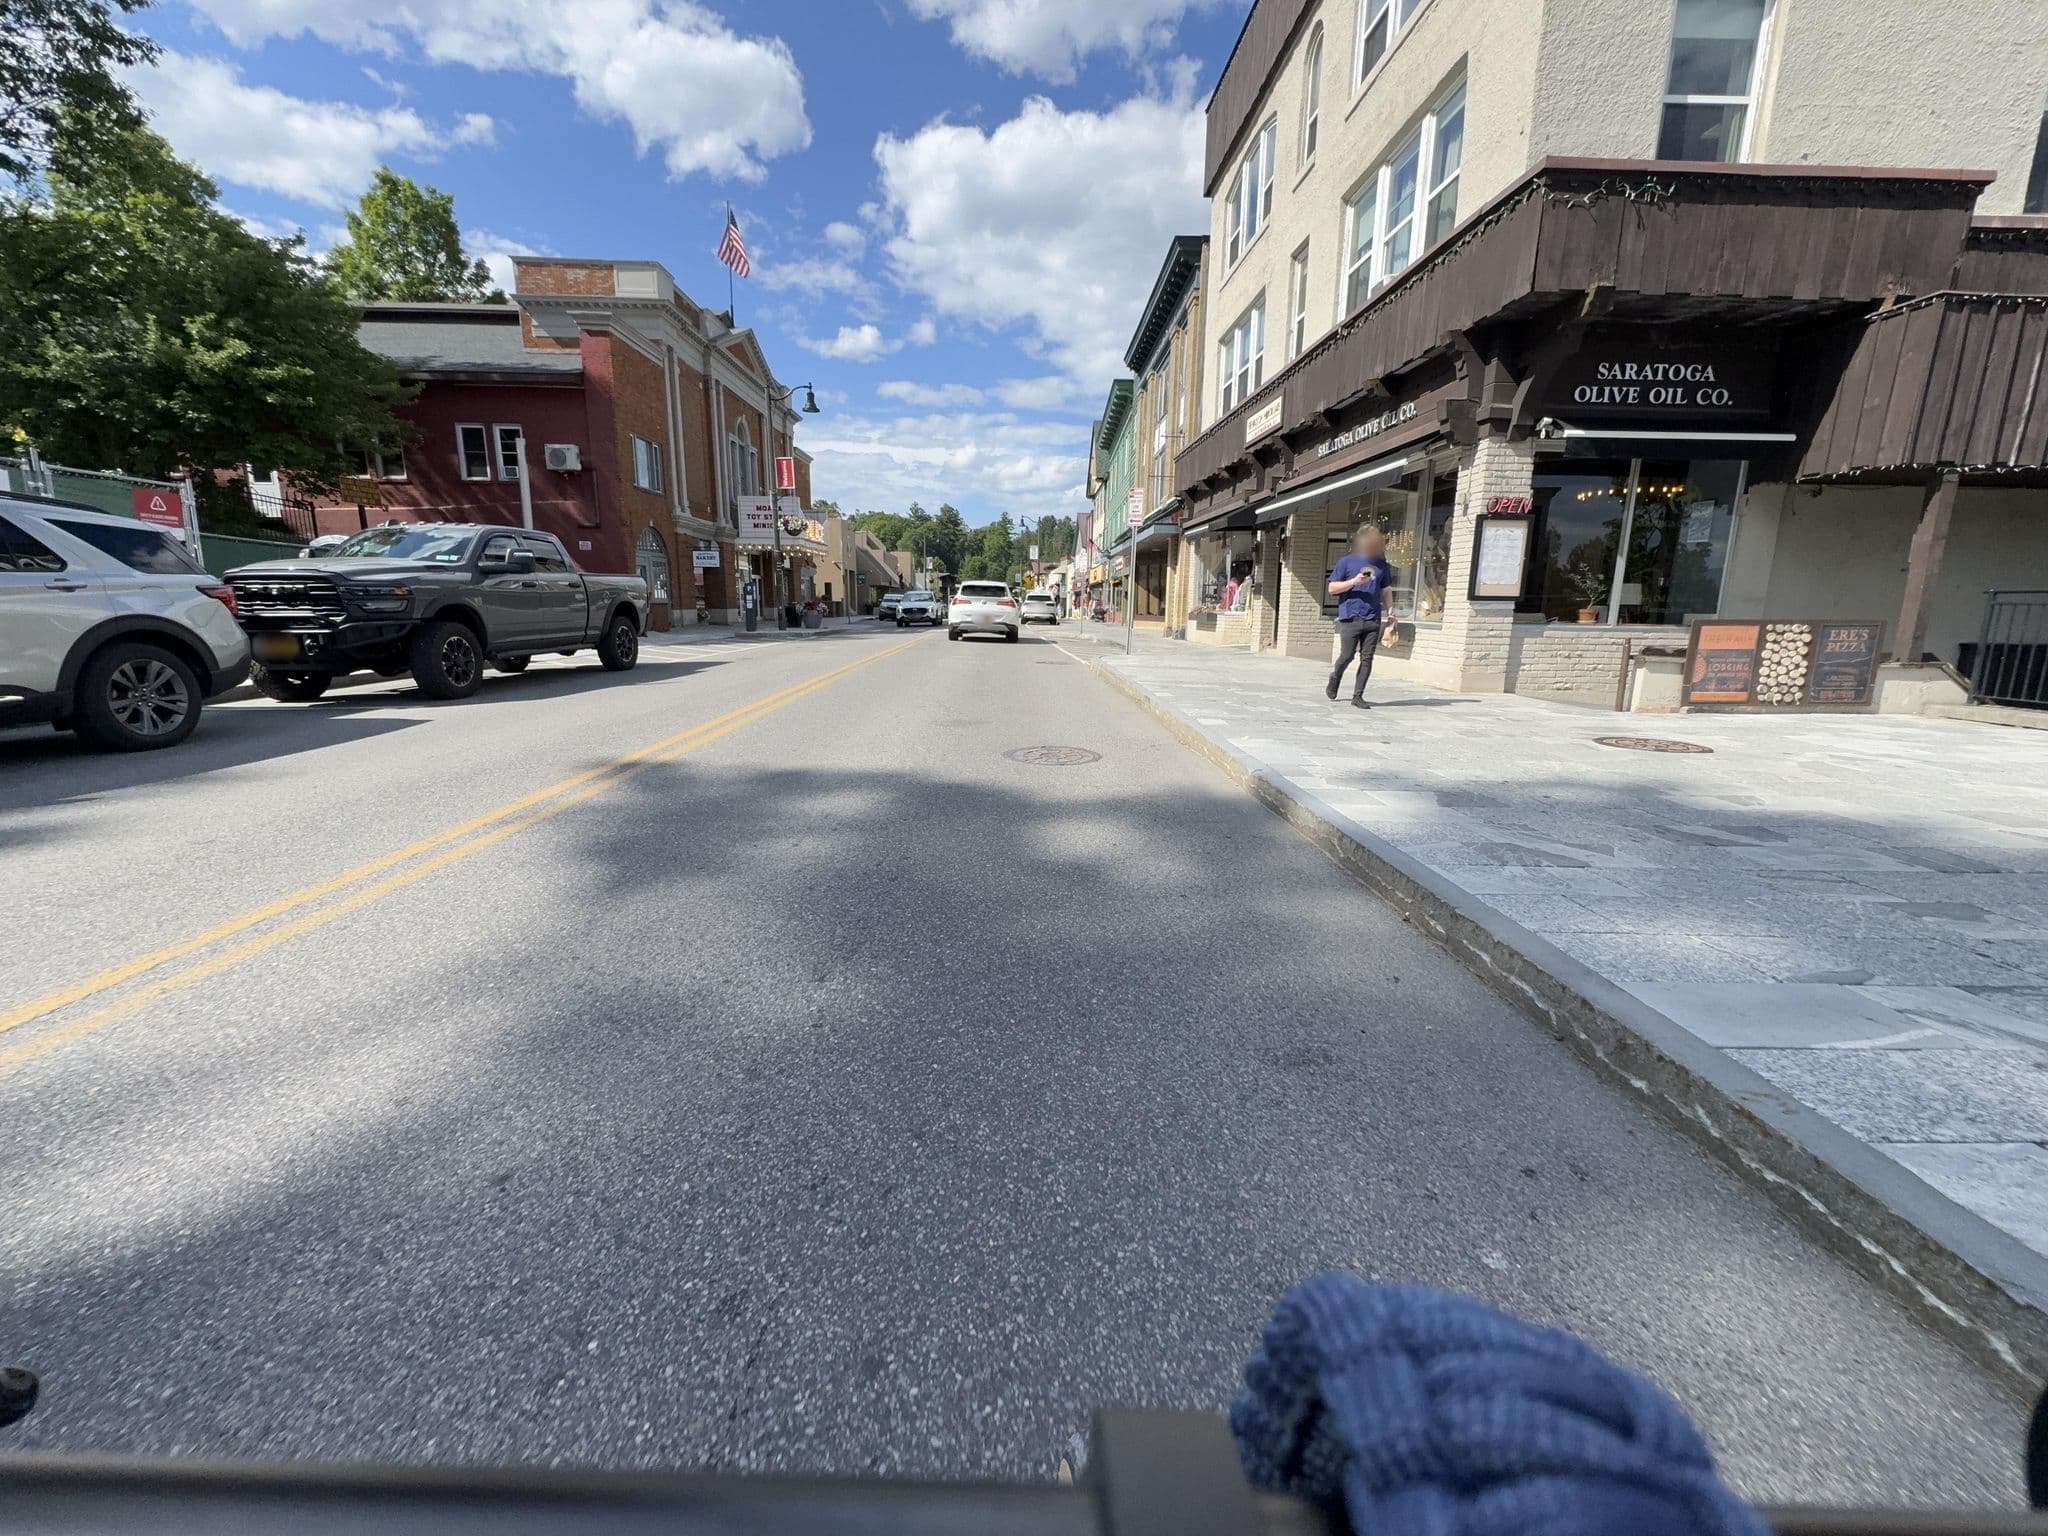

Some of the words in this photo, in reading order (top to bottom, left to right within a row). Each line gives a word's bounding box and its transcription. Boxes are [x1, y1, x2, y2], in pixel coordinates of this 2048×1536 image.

[1597, 362, 1716, 382] SARATOGA
[1574, 385, 1640, 404] OLIVE
[1649, 387, 1687, 405] OIL
[1696, 388, 1733, 406] CO.
[1318, 431, 1354, 457] SARATOGA
[1355, 419, 1380, 441] OLIVE
[1381, 411, 1398, 429] OIL
[1399, 402, 1417, 420] CO.
[1487, 496, 1533, 514] OPEN
[1829, 629, 1871, 641] ERE'S
[1826, 642, 1867, 653] PIZZA
